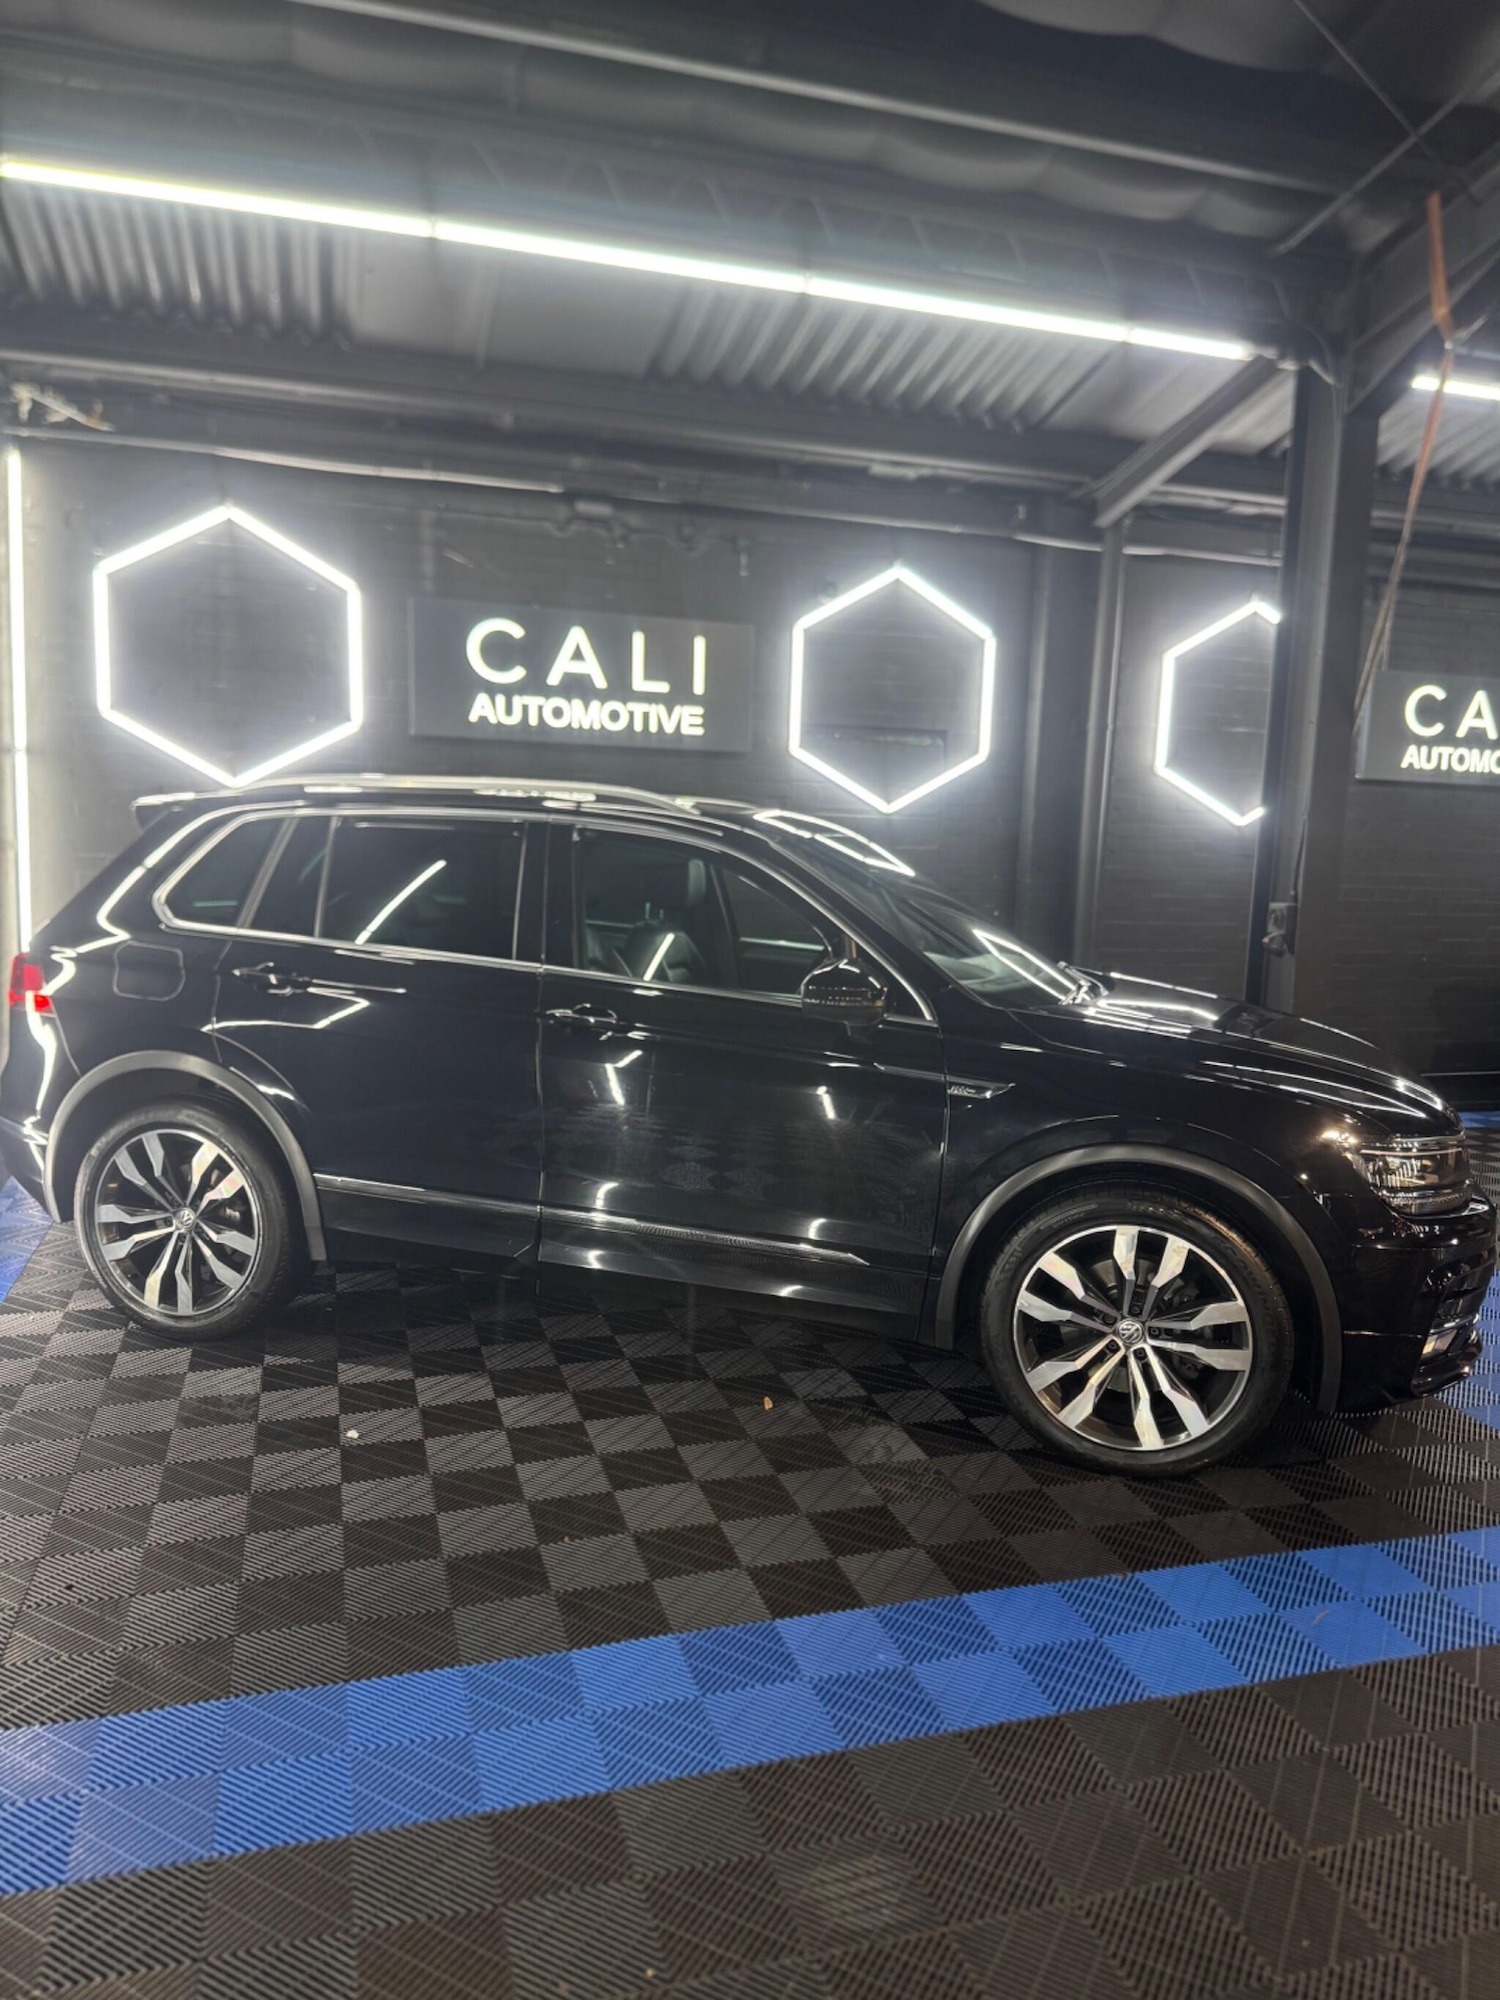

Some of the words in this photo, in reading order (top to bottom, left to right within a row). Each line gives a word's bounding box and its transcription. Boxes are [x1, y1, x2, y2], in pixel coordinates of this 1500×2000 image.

[466, 617, 706, 696] CALI
[468, 692, 705, 736] AUTOMOTIVE
[1404, 684, 1499, 741] CA
